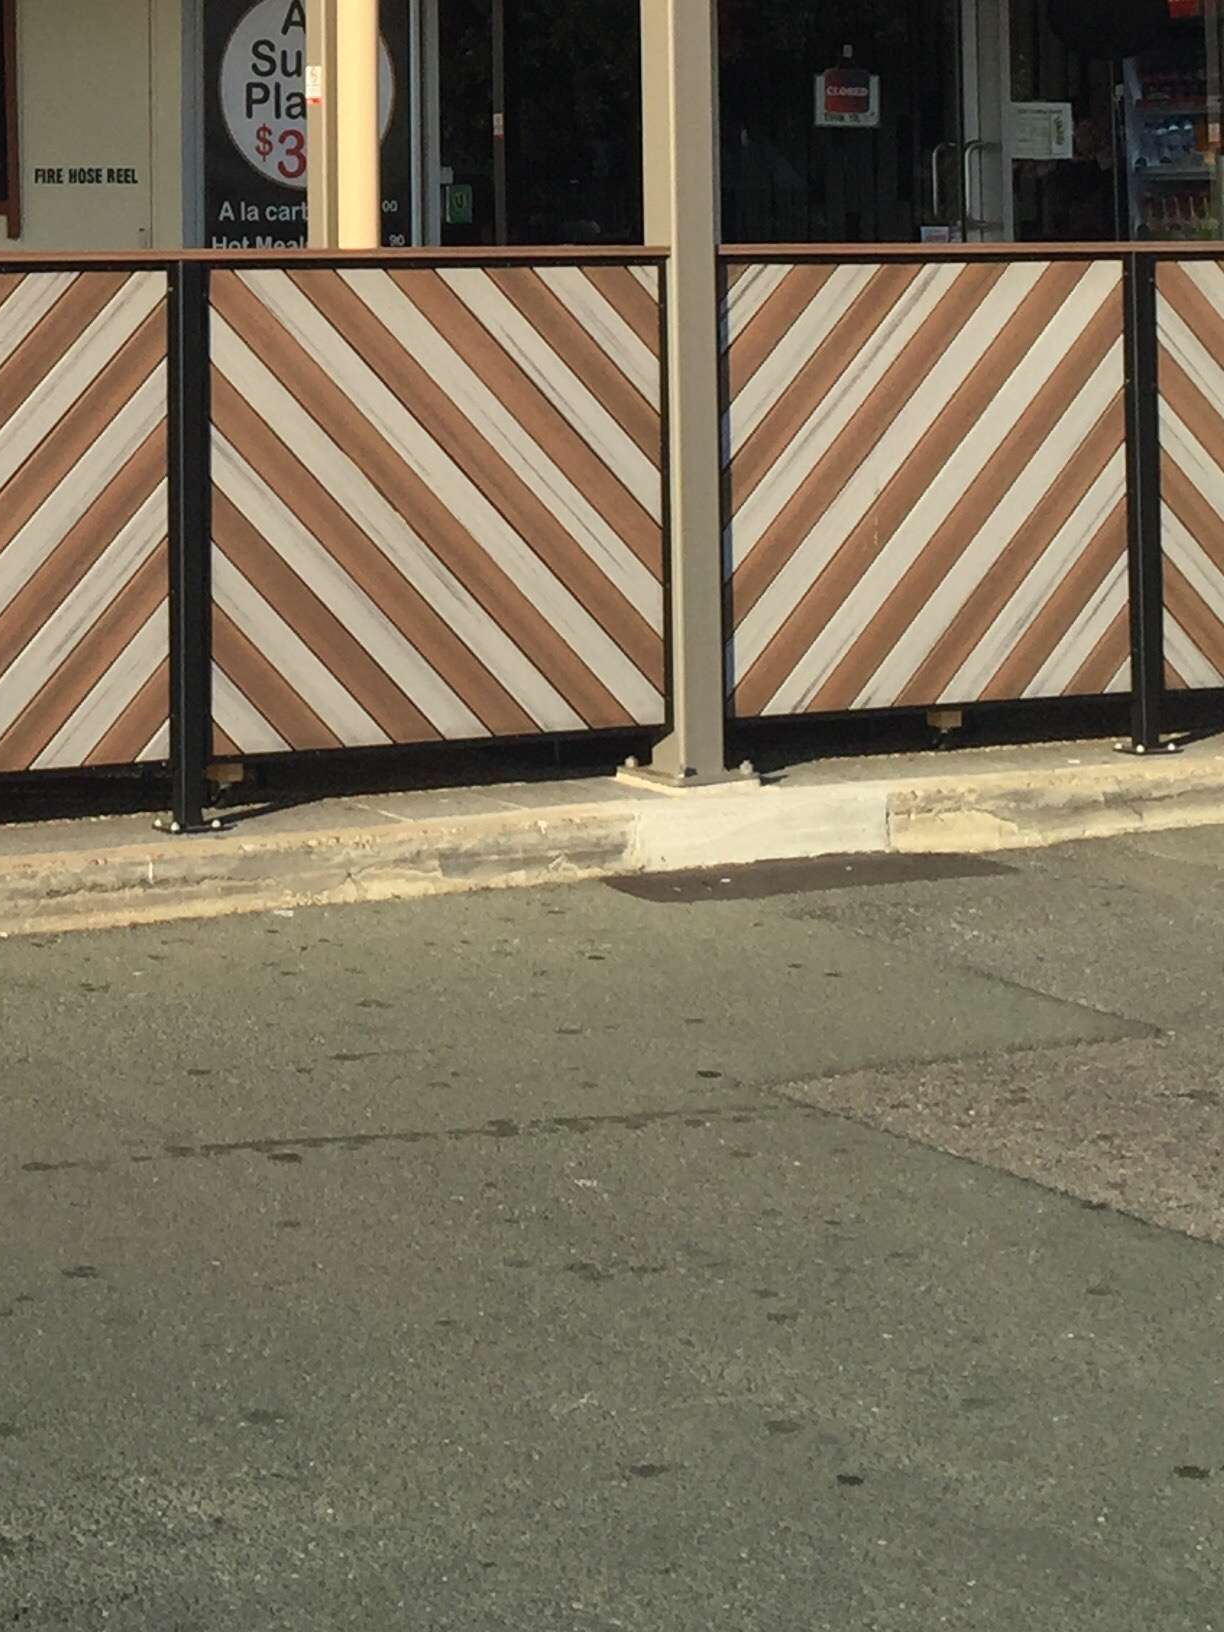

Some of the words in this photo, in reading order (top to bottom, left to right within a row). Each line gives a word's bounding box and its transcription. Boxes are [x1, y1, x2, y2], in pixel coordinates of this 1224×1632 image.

[34, 168, 64, 184] FIRE
[68, 168, 103, 184] HOSE
[106, 168, 138, 184] REEL
[219, 200, 235, 222] A
[240, 200, 259, 222] la
